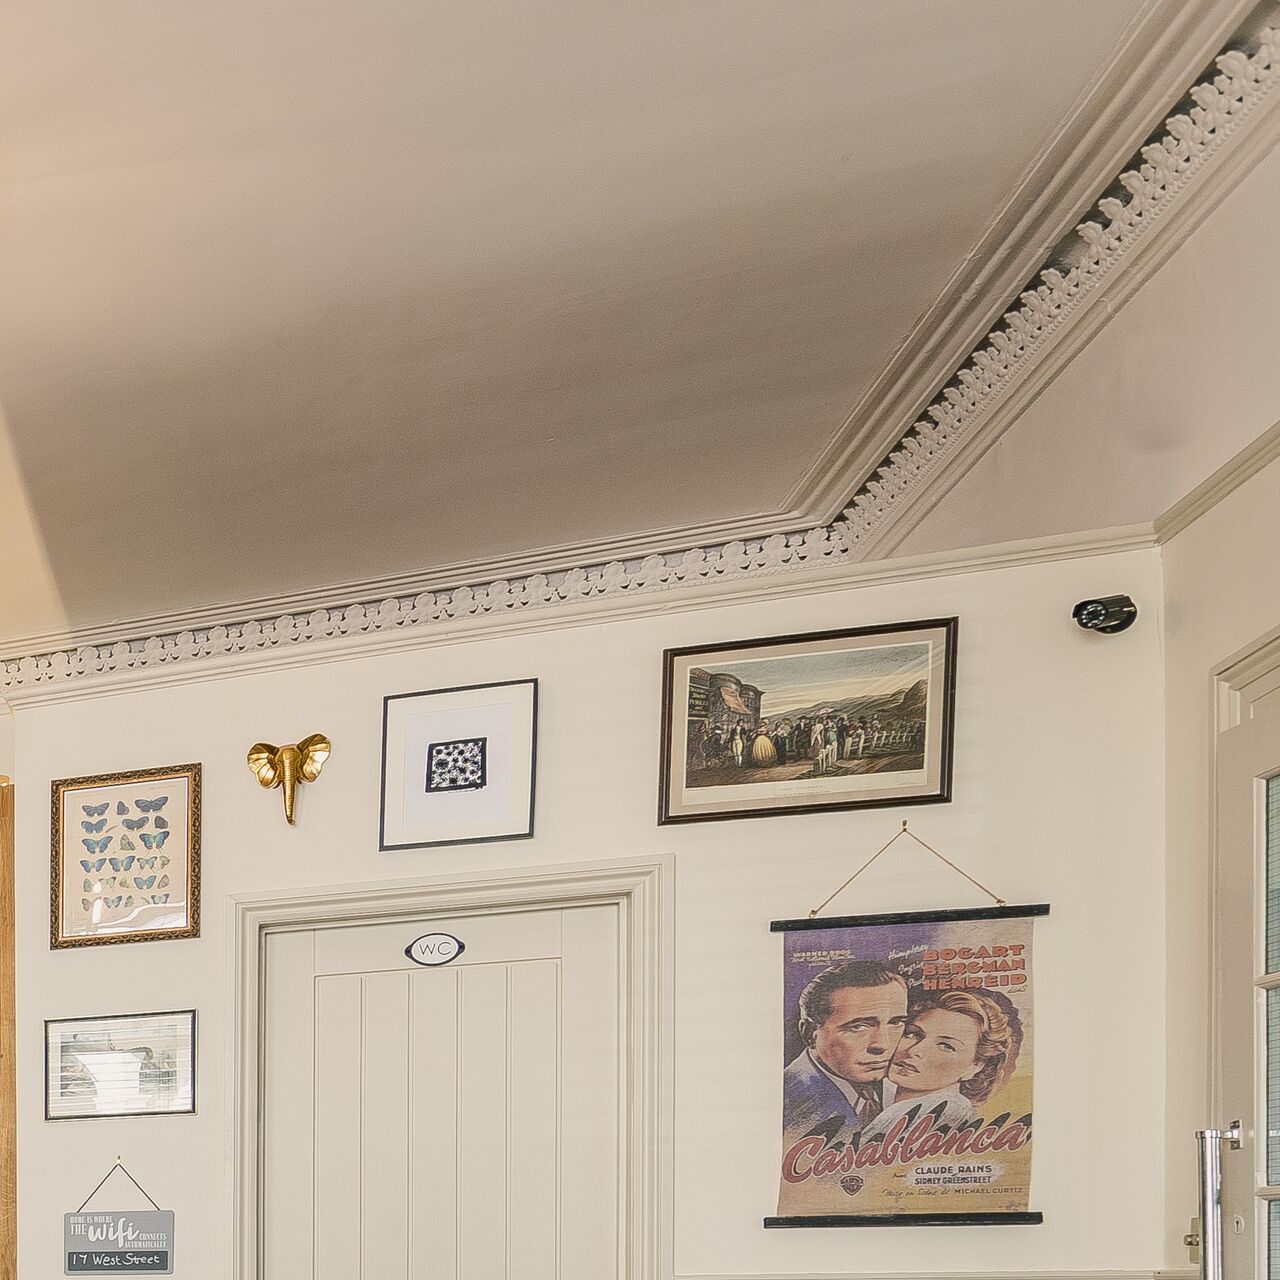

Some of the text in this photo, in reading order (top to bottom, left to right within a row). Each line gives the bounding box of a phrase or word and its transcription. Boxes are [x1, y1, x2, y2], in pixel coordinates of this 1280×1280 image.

[419, 941, 451, 956] WC
[922, 944, 1025, 961] BOGART
[922, 958, 1026, 976] BERGMAN
[922, 973, 1028, 991] HENREID
[782, 1113, 1027, 1184] Casablanca
[915, 1165, 993, 1176] CLAUDE RAINS
[914, 1175, 992, 1185] SIDNEY GREENSTREET
[954, 1187, 991, 1195] MICHAEL
[70, 1224, 87, 1235] THE
[73, 1252, 160, 1266] 17 West Street
